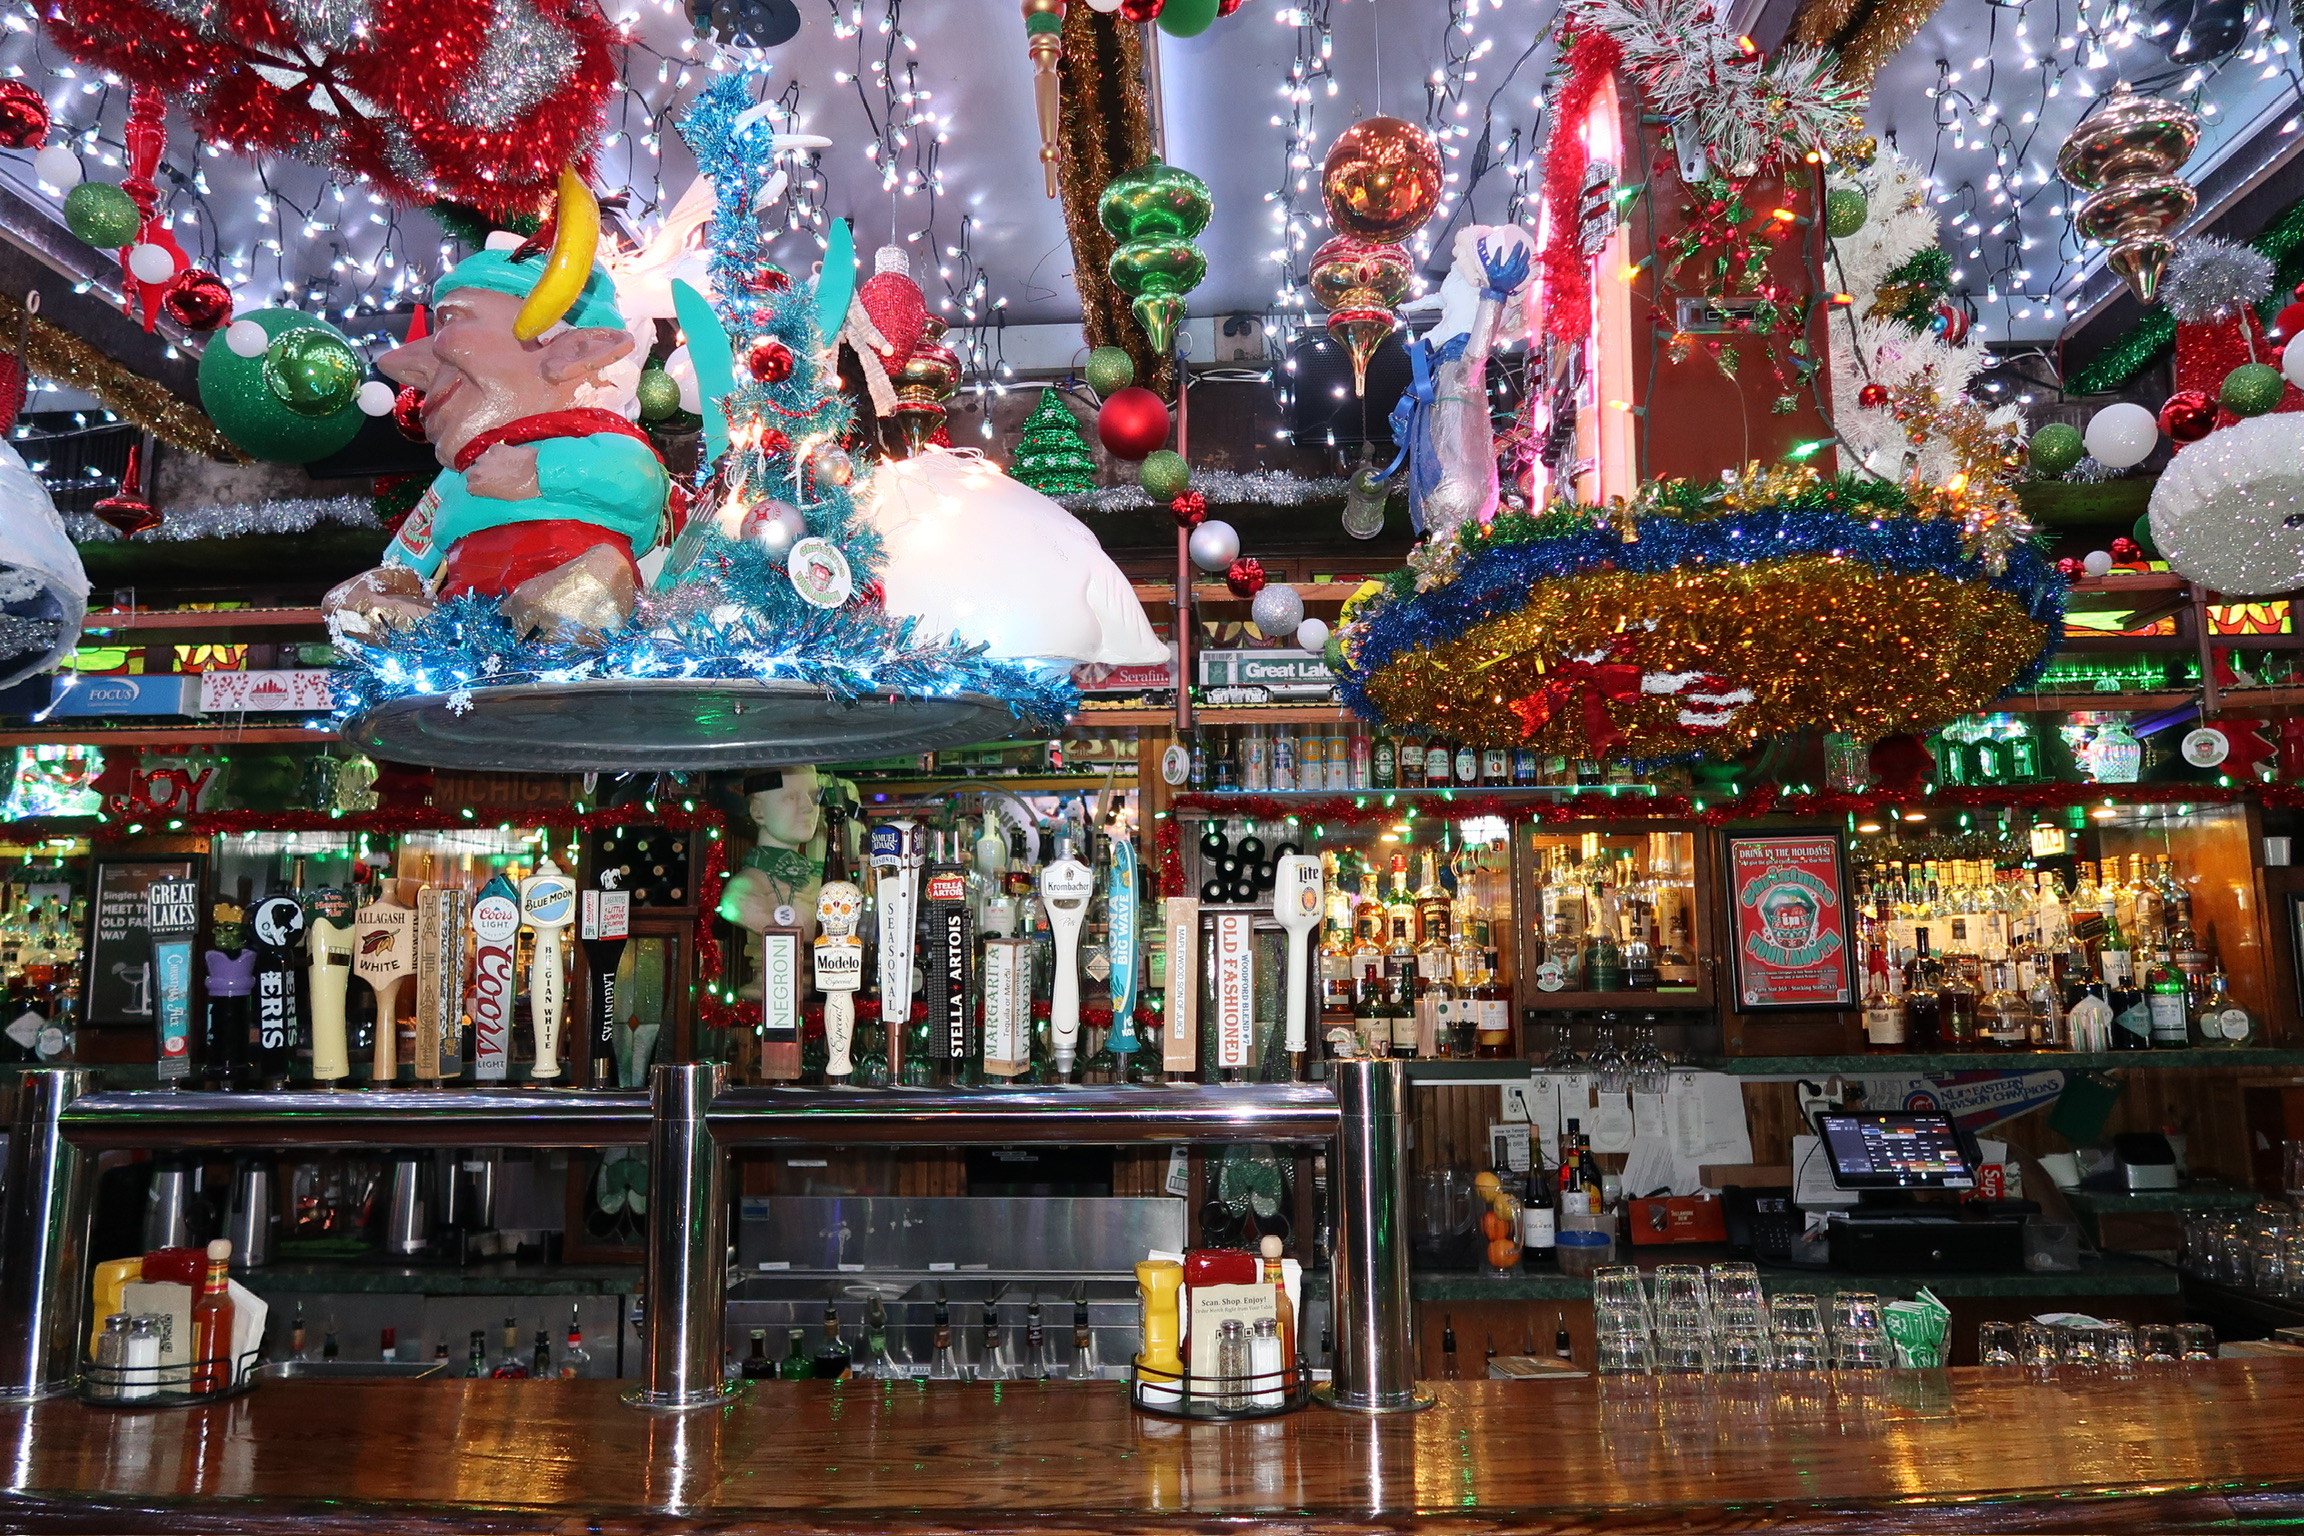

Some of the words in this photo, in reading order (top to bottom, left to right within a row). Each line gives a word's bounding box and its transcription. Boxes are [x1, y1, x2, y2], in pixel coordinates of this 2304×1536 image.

[1119, 669, 1169, 683] Serafin.
[1245, 662, 1296, 678] Great
[88, 689, 133, 701] FOCUS
[110, 767, 214, 813] JOY
[871, 832, 898, 843] SAMUEL
[871, 840, 896, 851] ADAMS
[1740, 849, 1764, 858] DRINK
[1775, 848, 1790, 857] THE
[1791, 847, 1830, 856] HOLIDAYS!
[932, 881, 964, 890] STELLA
[1299, 866, 1319, 884] Lite
[103, 891, 138, 901] Singles
[151, 883, 196, 905] GREAT
[932, 888, 964, 897] ARTOIS
[1048, 881, 1090, 892] Krombacher
[1743, 867, 1834, 906] Christmas
[102, 904, 133, 915] MEET
[525, 897, 549, 912] BLUE
[549, 888, 574, 902] MOON
[608, 906, 626, 914] LITTLE
[101, 917, 125, 928] OLD
[152, 904, 195, 927] LAKES
[356, 912, 406, 924] ALLAGASH
[479, 907, 513, 921] Coors
[481, 920, 509, 929] LIGHT
[1117, 894, 1130, 937] WAVE
[100, 930, 128, 941] WAY
[584, 927, 596, 936] IPA
[1222, 917, 1238, 953] OLD
[887, 902, 896, 1011] SEASONAL
[948, 915, 962, 982] ARTOIS
[1117, 940, 1129, 966] BIG
[1178, 928, 1186, 980] MAPLEWOOD
[1748, 933, 1786, 966] YOUR
[1788, 931, 1840, 966] MOUTH
[360, 960, 401, 972] WHITE
[818, 955, 860, 970] Modelo
[772, 939, 789, 1026] NEGRONI
[1177, 981, 1185, 996] SON
[1240, 954, 1250, 1001] WOODFORD
[260, 970, 284, 1050] ERIS
[285, 969, 298, 1048] ERIS
[476, 944, 514, 1059] Coors
[602, 972, 615, 1042] LAGUNITAS
[985, 947, 1000, 1058] MARGARITA
[1005, 996, 1010, 1006] or
[1022, 945, 1030, 1055] MARGARITA
[1176, 998, 1184, 1008] OF
[1223, 958, 1240, 1064] FASHIONED
[950, 993, 964, 1058] STELLA
[1003, 1008, 1011, 1038] Tequila
[1176, 1012, 1184, 1036] JUICE
[1240, 1002, 1250, 1032] BLEND
[544, 1008, 554, 1050] WHITE
[477, 1060, 504, 1069] LIGHT
[1940, 1095, 1992, 1111] DIVISION
[1992, 1079, 2060, 1102] CHAMPIONS
[1972, 1078, 2024, 1096] EASTERN
[1980, 1168, 2001, 1198] Sup
[1201, 1299, 1221, 1307] Scan.
[1222, 1298, 1242, 1306] Shop.
[1243, 1296, 1268, 1305] Enjoy!
